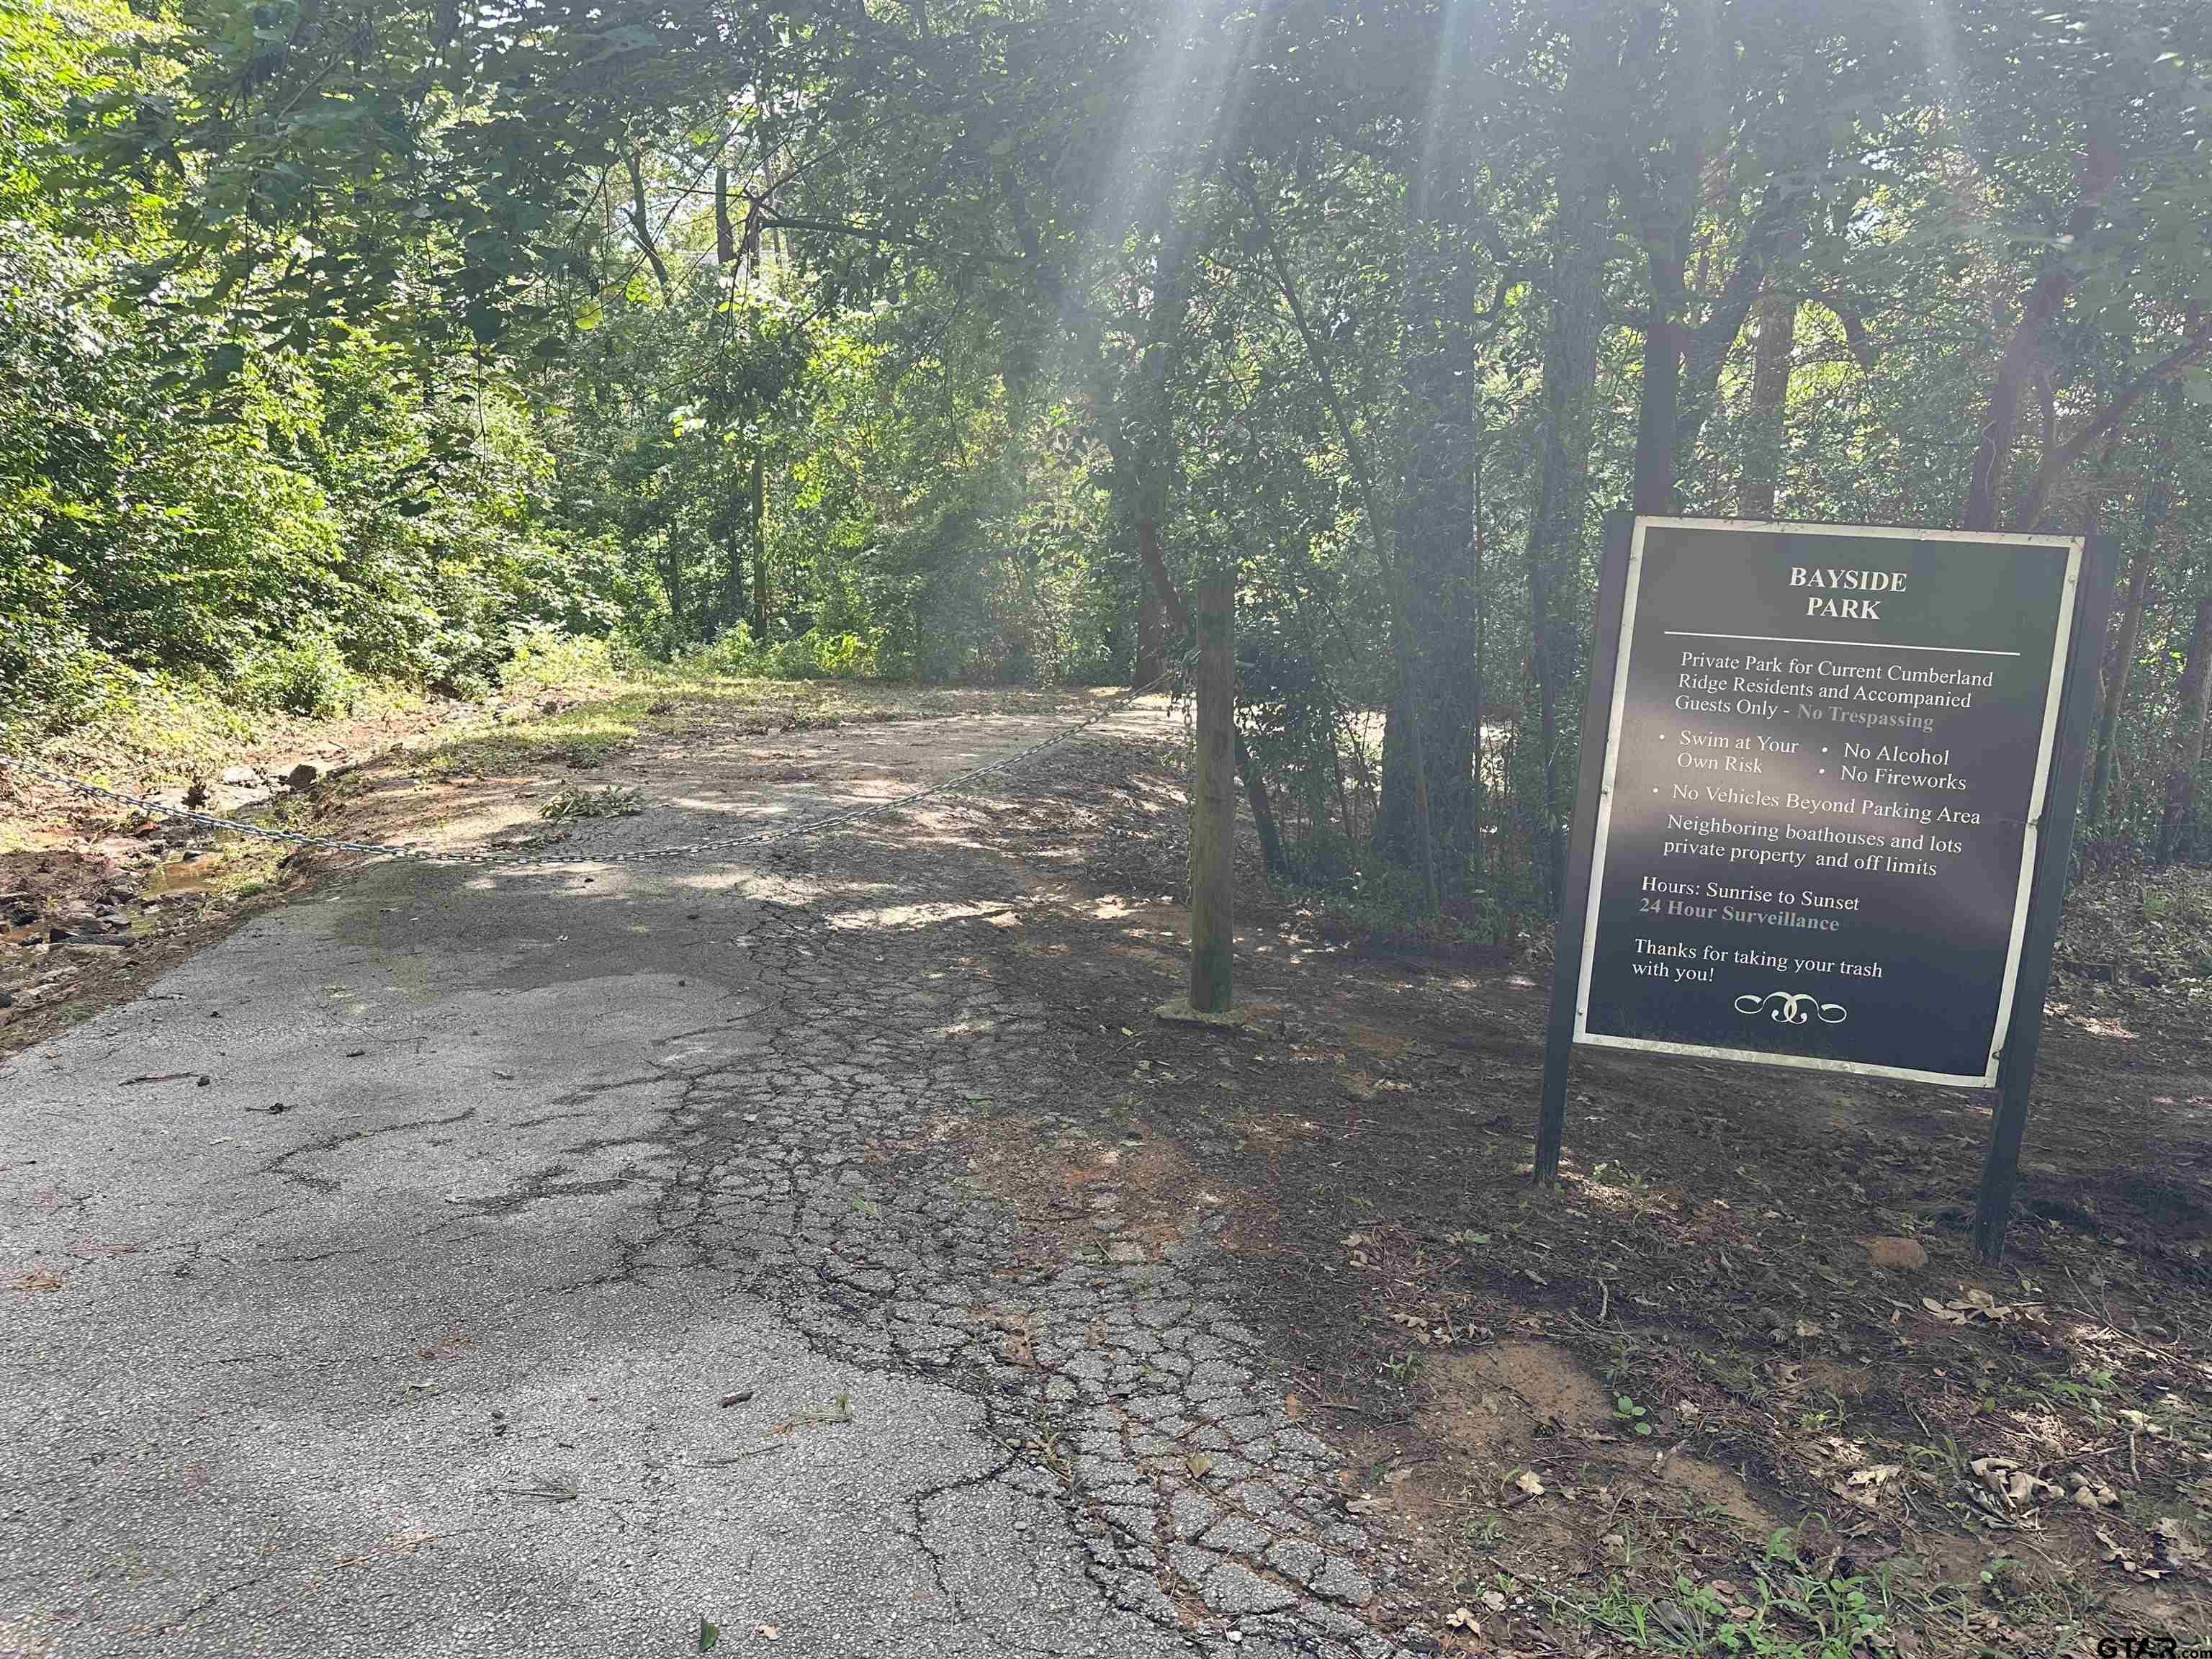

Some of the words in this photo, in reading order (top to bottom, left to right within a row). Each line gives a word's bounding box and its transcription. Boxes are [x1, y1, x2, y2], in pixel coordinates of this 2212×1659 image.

[1789, 567, 1907, 592] BAYSIDE
[1807, 597, 1881, 620] PARK
[1681, 652, 1740, 670] Private
[1745, 655, 1783, 673] Park
[1788, 658, 1814, 675] for
[1817, 660, 1883, 680] Current
[1887, 665, 1993, 687] Cumberland
[1678, 673, 1727, 694] Ridge
[1733, 677, 1813, 697] Residents
[1818, 684, 1850, 699] and
[1853, 685, 1972, 709] Accompanied
[1676, 694, 1731, 713] Guests
[1736, 698, 1779, 720] Only
[1799, 703, 1822, 719] No
[1829, 706, 1933, 732] Trespassing
[1680, 730, 1729, 748] Swim
[1735, 737, 1752, 750] at
[1756, 736, 1799, 753] Your
[1844, 742, 1871, 760] No
[1876, 746, 1949, 765] Alcohol
[1677, 752, 1718, 770] Own
[1725, 755, 1763, 773] Risk
[1841, 765, 1868, 782] No
[1875, 768, 1966, 790] Fireworks
[1673, 783, 1699, 801] No
[1706, 786, 1779, 807] Vehicles
[1785, 793, 1856, 814] Beyond
[1861, 800, 1933, 824] Parking
[1936, 806, 1980, 824] Area
[1667, 814, 1779, 842] Neighboring
[1785, 824, 1884, 847] boathouses
[1890, 835, 1924, 850] and
[1929, 835, 1962, 853] lots
[1663, 838, 1725, 857] private
[1730, 848, 1807, 868] property
[1815, 853, 1848, 868] and
[1853, 854, 1884, 871] off
[1886, 856, 1937, 876] limits
[1642, 876, 1700, 895] Hours:
[1706, 882, 1773, 902] Sunrise
[1779, 891, 1795, 904] to
[1801, 891, 1860, 911] Sunset
[1640, 897, 1661, 913] 24
[1668, 900, 1717, 918] Hour
[1722, 905, 1839, 930] Surveillance
[1632, 961, 1669, 977] with
[1674, 967, 1714, 982] you!
[1635, 938, 1696, 959] Thanks
[1703, 945, 1729, 962] for
[1734, 950, 1789, 972] taking
[1794, 958, 1835, 974] your
[1840, 961, 1882, 978] trash
